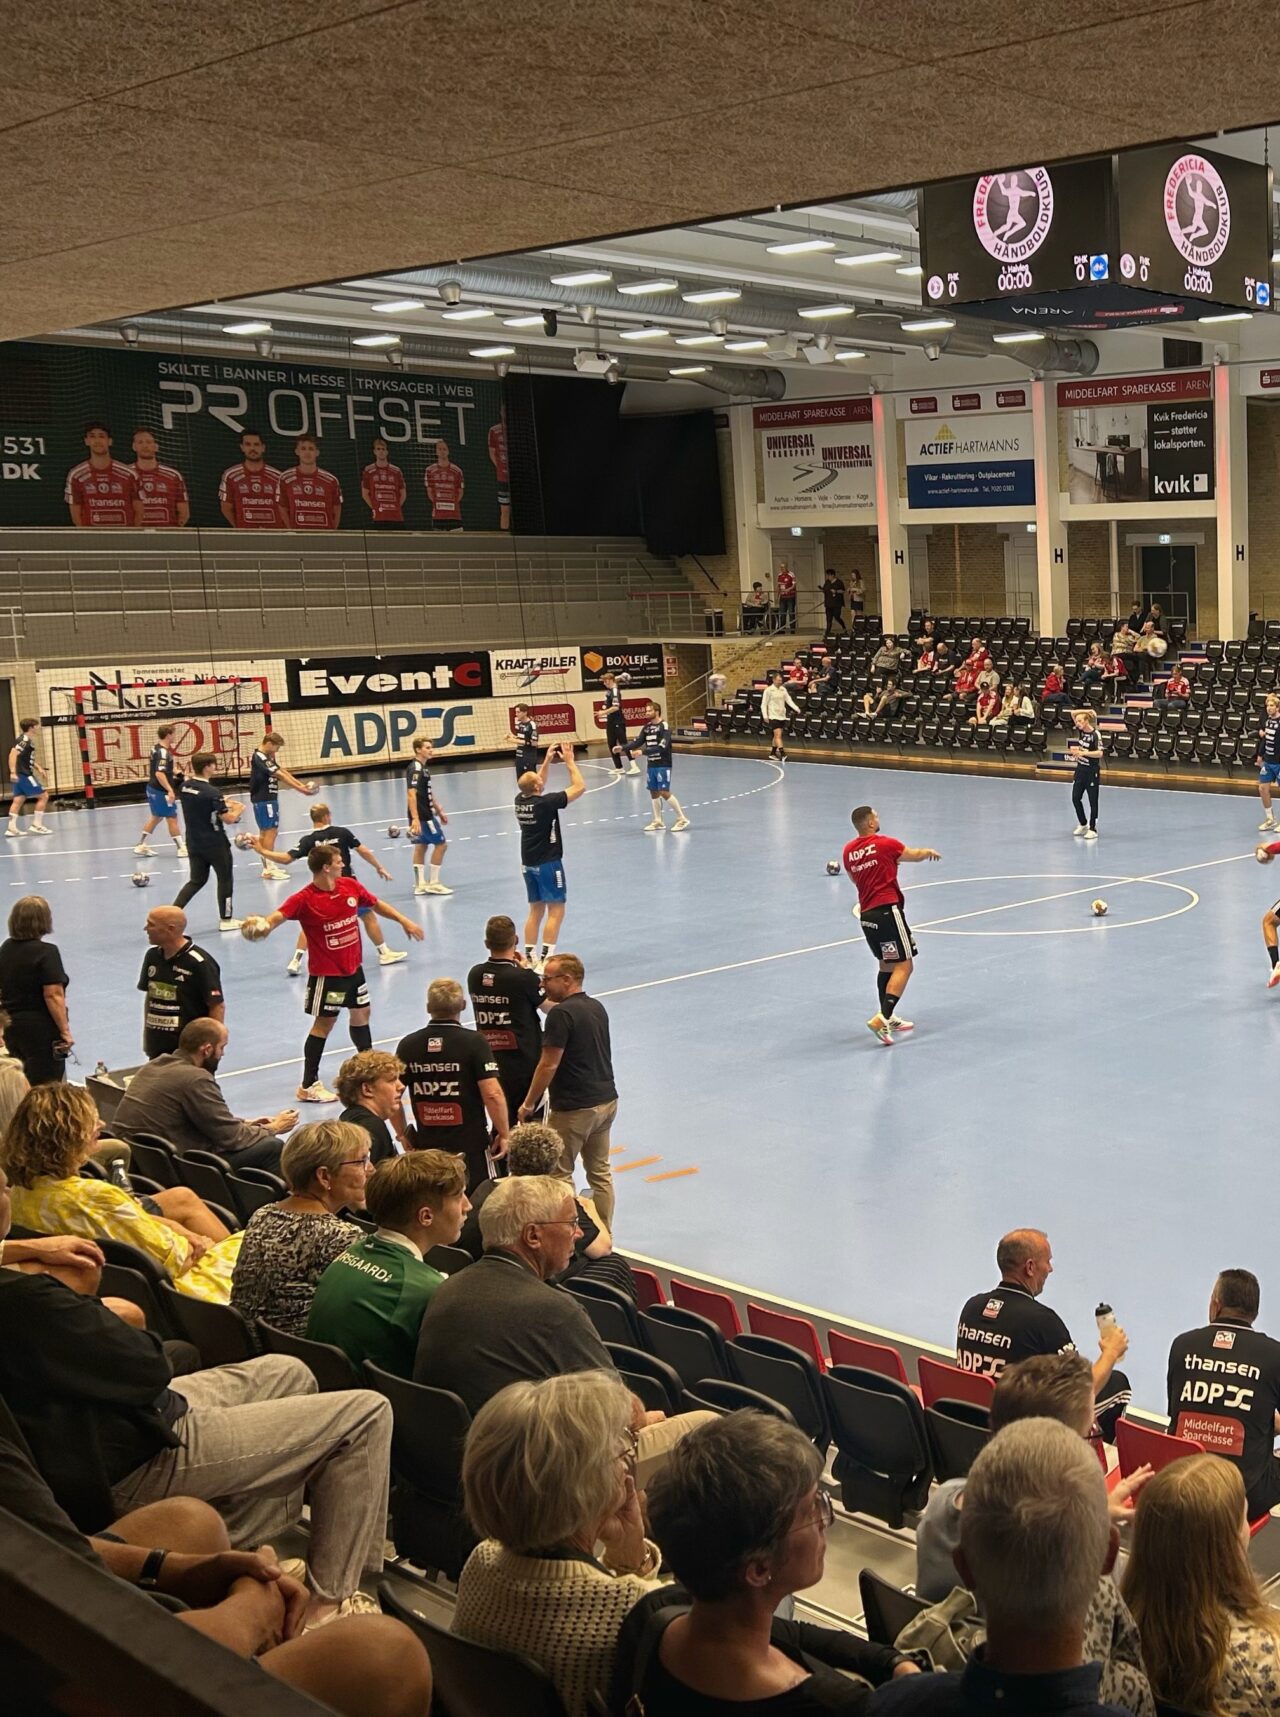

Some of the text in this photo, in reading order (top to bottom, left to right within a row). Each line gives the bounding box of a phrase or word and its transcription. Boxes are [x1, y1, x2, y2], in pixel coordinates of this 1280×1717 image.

[1166, 158, 1206, 221] FREDERICIA
[1075, 263, 1086, 281] 0
[1140, 266, 1148, 282] 0
[948, 281, 957, 298] 0
[997, 272, 1033, 291] 00:00
[1183, 273, 1213, 294] 00:00
[1245, 285, 1253, 301] 0
[158, 361, 475, 398] SKILTE BANNER MESSE TRYKSAGER WEB
[1065, 385, 1119, 400] MIDDELFART
[1121, 381, 1177, 396] SPAREKASSE
[267, 388, 476, 446] OFFSET
[803, 406, 847, 419] SPAREKASSE
[852, 405, 872, 416] AREN
[1153, 410, 1208, 423] Kvik Fredericia
[1171, 425, 1198, 436] støtter
[766, 433, 815, 450] UNIVERSAL
[919, 438, 1020, 456] ACTIEF HARTMANNS
[1154, 439, 1206, 451] lokalsporten.
[821, 444, 872, 461] UNIVERSAL
[924, 473, 939, 481] Vikar
[1154, 474, 1191, 494] kvik
[894, 550, 904, 566] H
[1054, 548, 1064, 564] H
[1236, 545, 1245, 561] H
[495, 656, 577, 671] KRAFT BILER
[298, 661, 482, 697] EventC
[472, 993, 510, 1005] hansen
[409, 1061, 460, 1074] thansen
[1184, 1353, 1261, 1381] thansen
[1183, 1418, 1235, 1436] Middelfart
[1182, 1429, 1234, 1447] Sparekasse
